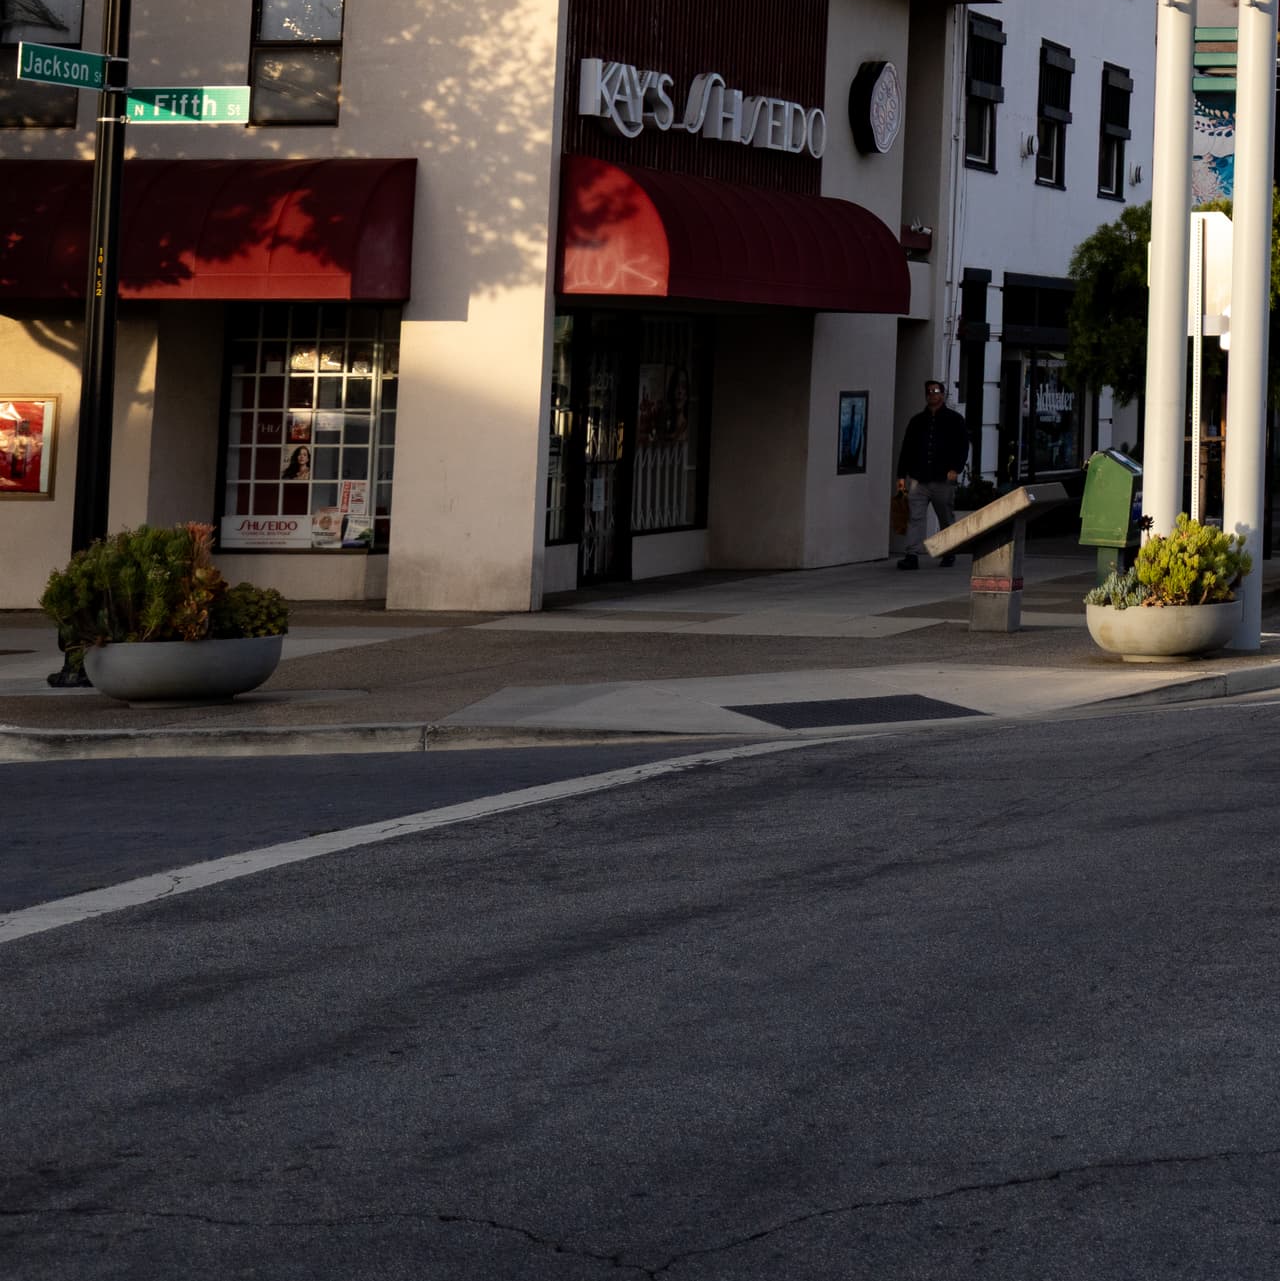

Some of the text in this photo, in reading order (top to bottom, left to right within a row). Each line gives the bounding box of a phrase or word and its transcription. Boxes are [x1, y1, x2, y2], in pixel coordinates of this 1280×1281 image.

[24, 51, 89, 81] Jackson
[134, 95, 241, 117] N Fifth St
[236, 519, 298, 531] SHISEIDO
